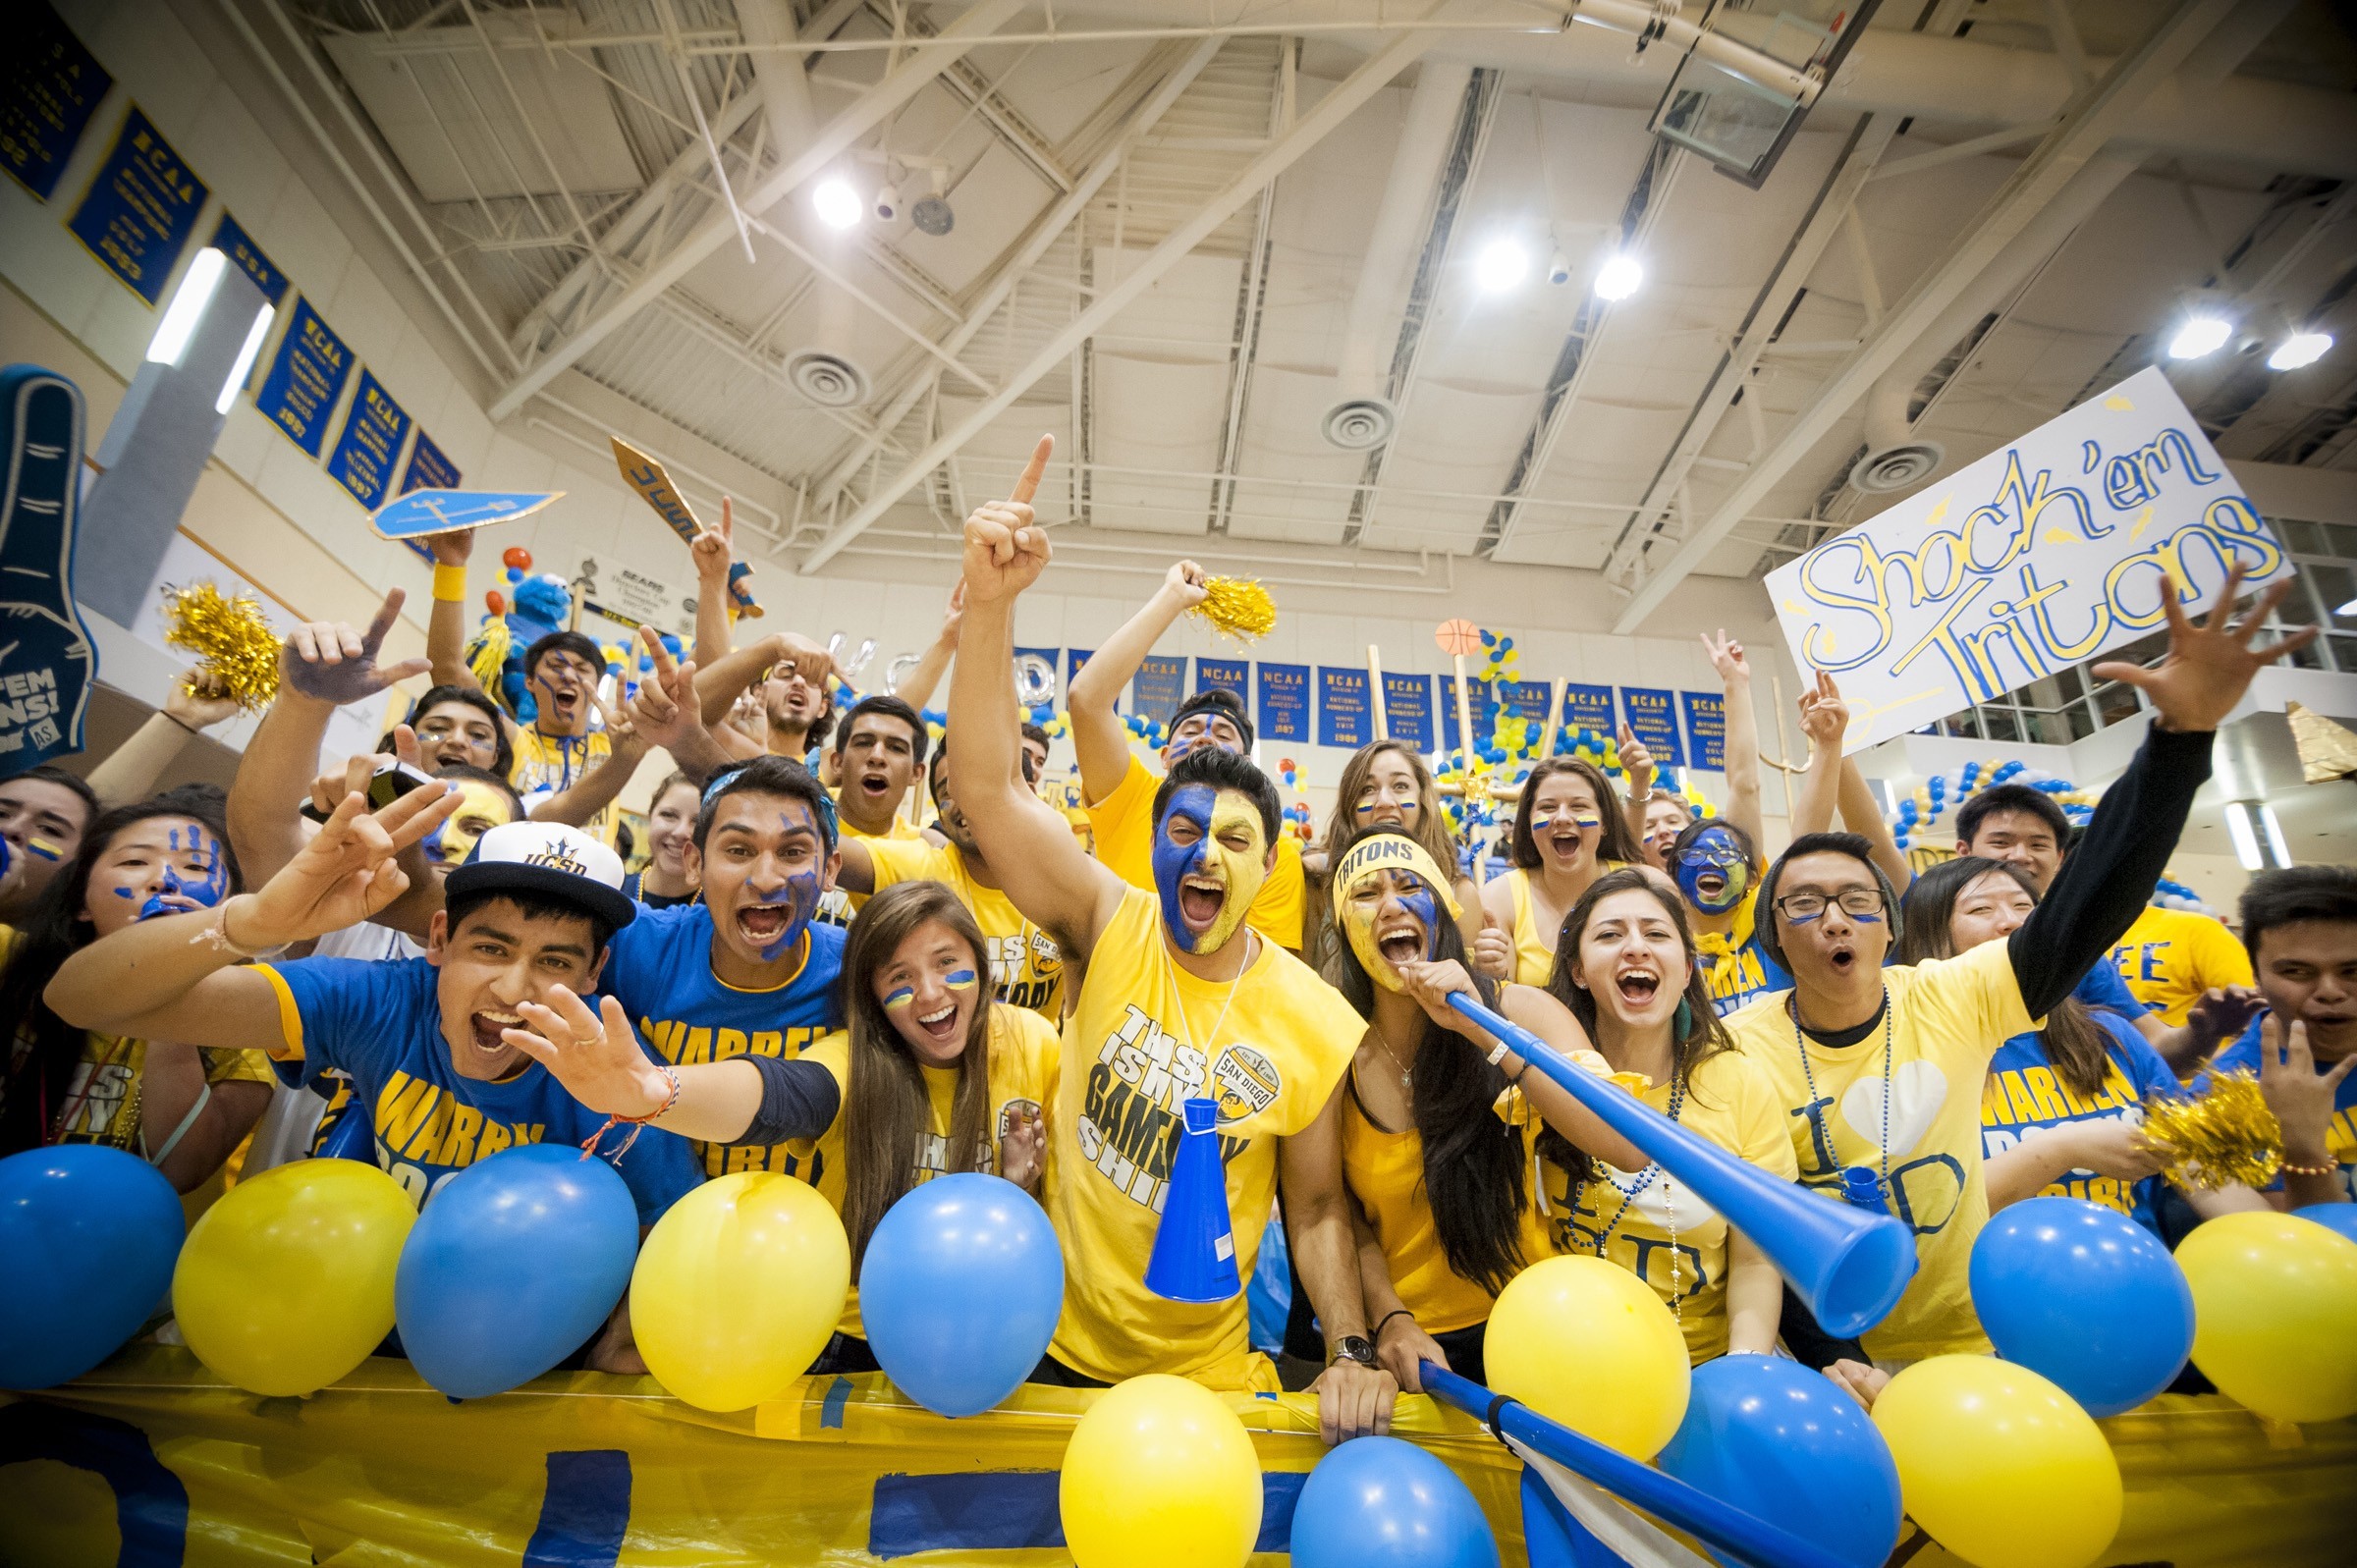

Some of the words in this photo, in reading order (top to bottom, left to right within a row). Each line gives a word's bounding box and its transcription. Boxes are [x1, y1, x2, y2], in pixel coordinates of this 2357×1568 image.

[133, 132, 192, 202] NCAA
[236, 244, 268, 284] USA
[306, 319, 340, 366] NCAA
[367, 389, 399, 429] NCAA
[1889, 495, 2283, 706] Tritons
[1202, 668, 1242, 681] NCAA
[1263, 672, 1304, 685] NCAA
[1326, 674, 1363, 687] NCAA
[1388, 679, 1423, 692] NCAA
[1448, 683, 1484, 696] NAA
[1567, 692, 1610, 706] NCAA
[1630, 695, 1668, 708] NCAA
[1337, 839, 1413, 892] TRITONS
[1124, 1002, 1208, 1088] THIS
[1220, 1057, 1243, 1082] SAN
[1240, 1077, 1270, 1106] DIEGO
[374, 1069, 546, 1167] WARR
[1084, 1062, 1252, 1184] GAMEY
[1076, 1113, 1171, 1217] SHI
